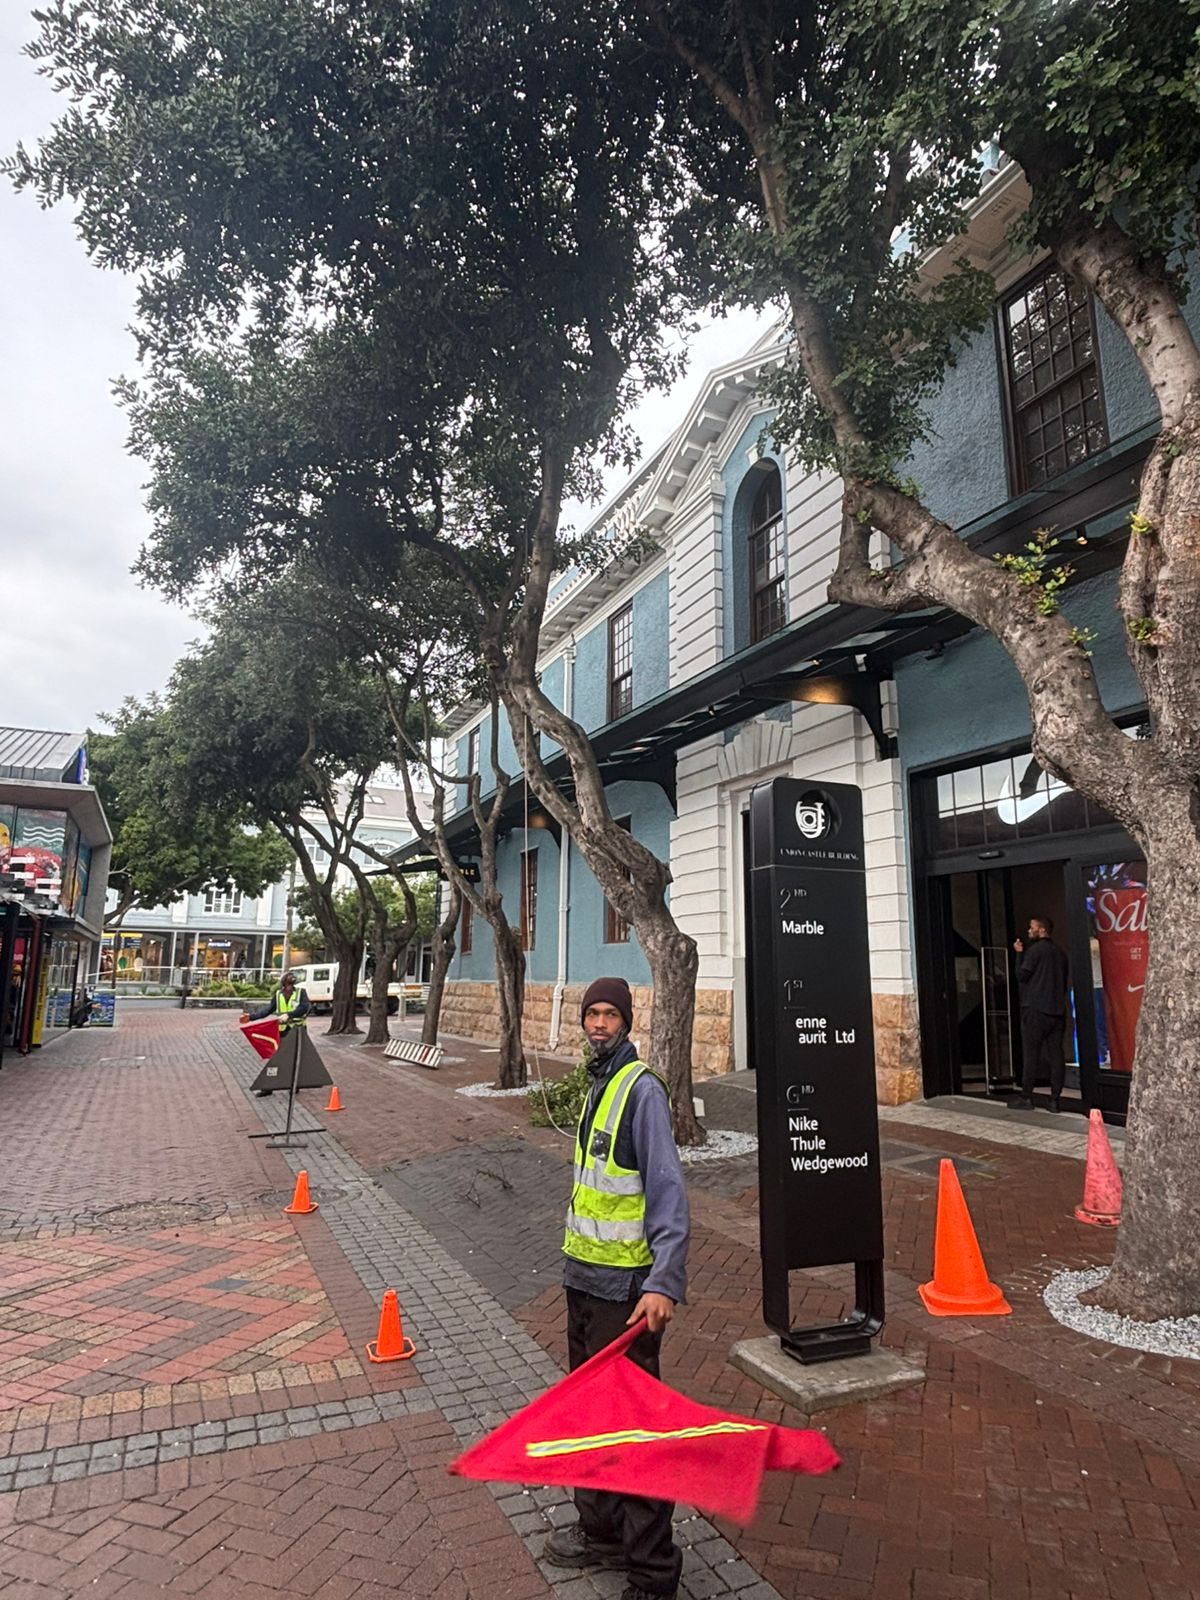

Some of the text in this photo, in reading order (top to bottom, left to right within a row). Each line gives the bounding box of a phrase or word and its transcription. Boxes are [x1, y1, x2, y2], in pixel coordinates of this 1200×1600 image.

[1095, 891, 1148, 932] Sal
[782, 920, 825, 935] Marble
[795, 1017, 827, 1029] enne
[798, 1029, 856, 1044] aurit Ltd
[788, 1116, 819, 1131] Nike
[790, 1136, 826, 1151] Thule
[791, 1152, 868, 1174] Wedgewood
